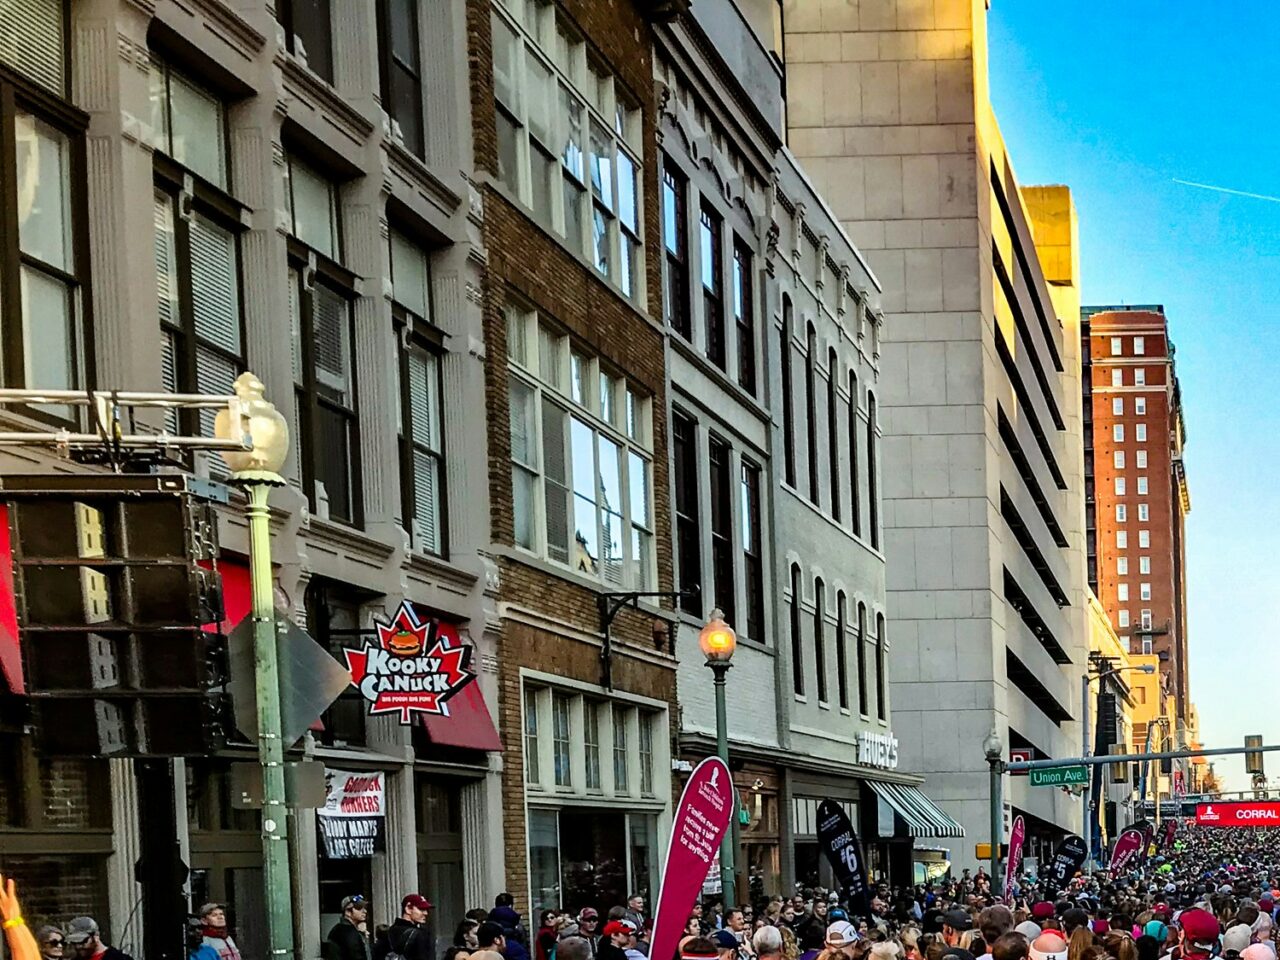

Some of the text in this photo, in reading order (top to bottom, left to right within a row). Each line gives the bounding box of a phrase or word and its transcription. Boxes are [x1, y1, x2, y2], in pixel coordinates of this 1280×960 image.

[1033, 770, 1084, 783] Union Ave.
[1236, 809, 1278, 819] CORRAL
[831, 831, 853, 851] CORRAL
